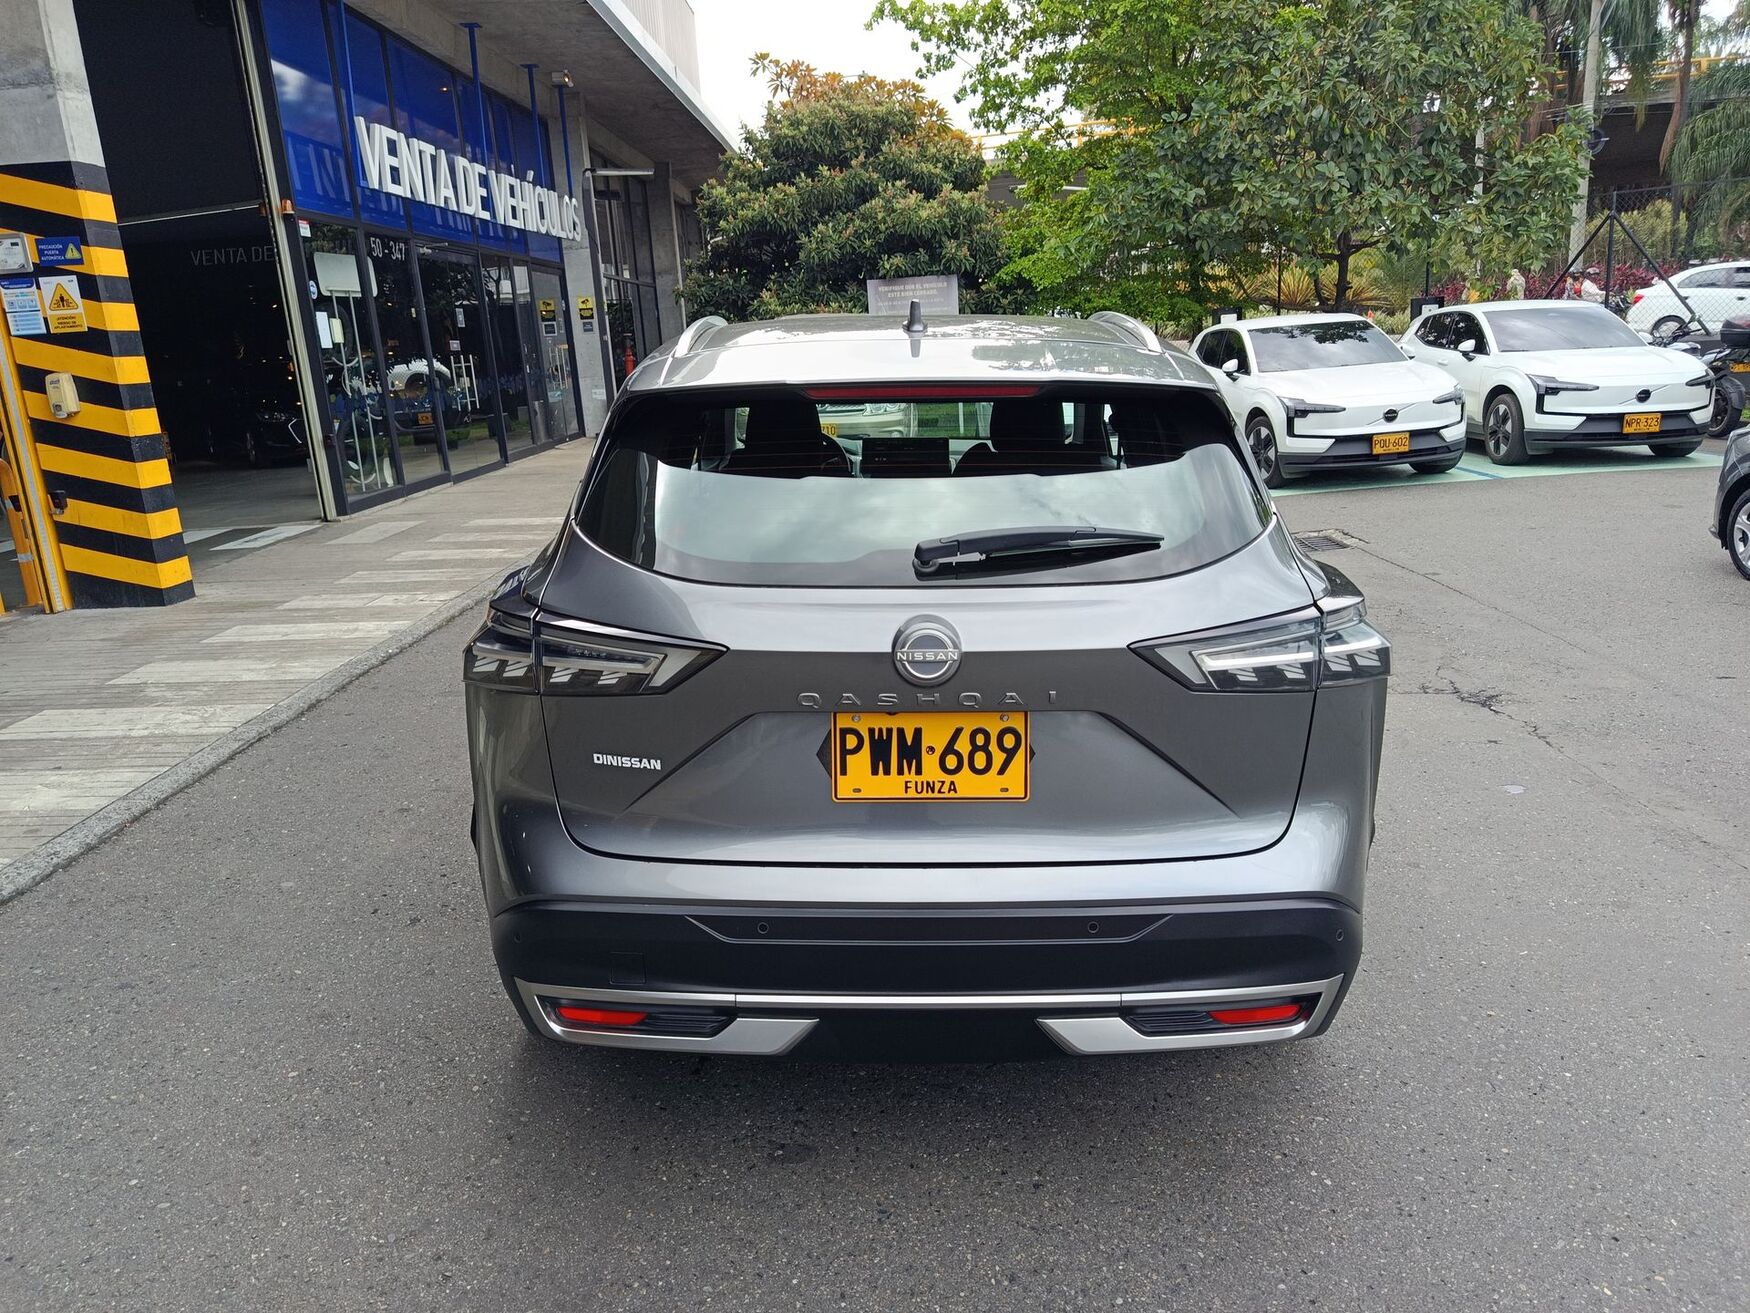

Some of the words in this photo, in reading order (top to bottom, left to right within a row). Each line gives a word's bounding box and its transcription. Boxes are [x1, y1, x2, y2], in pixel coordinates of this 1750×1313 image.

[354, 116, 458, 212] VENTA
[455, 155, 491, 220] DE
[488, 169, 582, 242] VEHÍCULOS
[190, 247, 248, 267] VENTA
[252, 245, 275, 263] DE
[370, 237, 383, 258] 50
[389, 241, 405, 261] 347
[896, 651, 959, 660] NISSAN
[797, 690, 1057, 709] QASHQAI
[593, 753, 662, 770] DINISSAN
[904, 780, 958, 794] FUNZA
